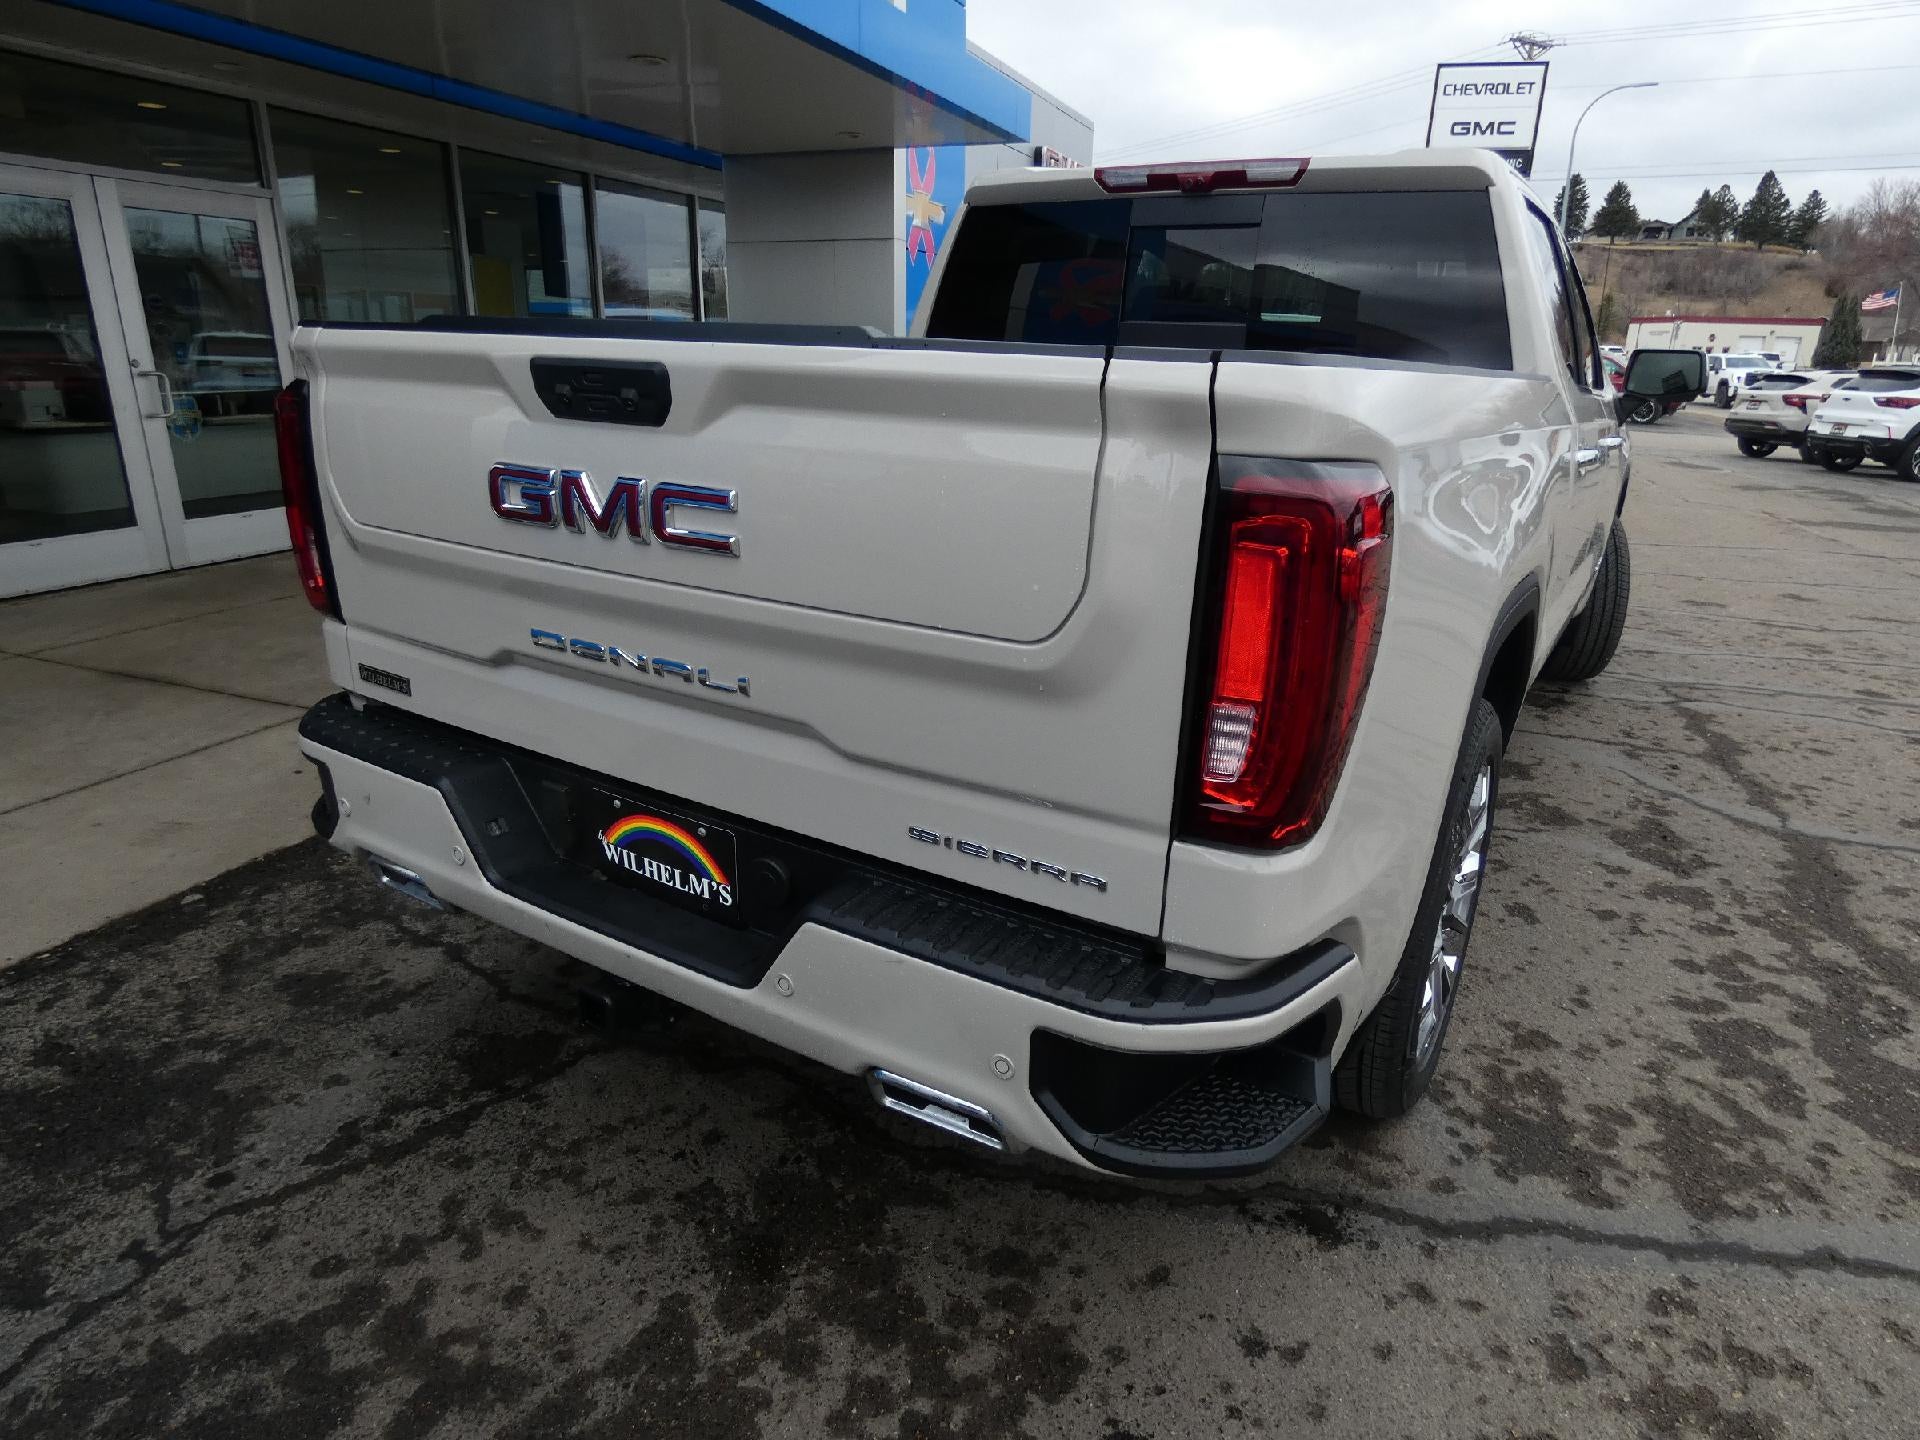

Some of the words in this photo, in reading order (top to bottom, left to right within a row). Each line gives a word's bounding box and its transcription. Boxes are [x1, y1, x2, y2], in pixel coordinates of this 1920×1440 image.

[1442, 82, 1536, 96] CHEVROLET
[1450, 121, 1516, 136] GMC
[488, 461, 741, 558] GMC
[531, 628, 750, 698] DENALI
[602, 840, 733, 906] WILHELM'S
[908, 826, 1108, 892] SIERRA
